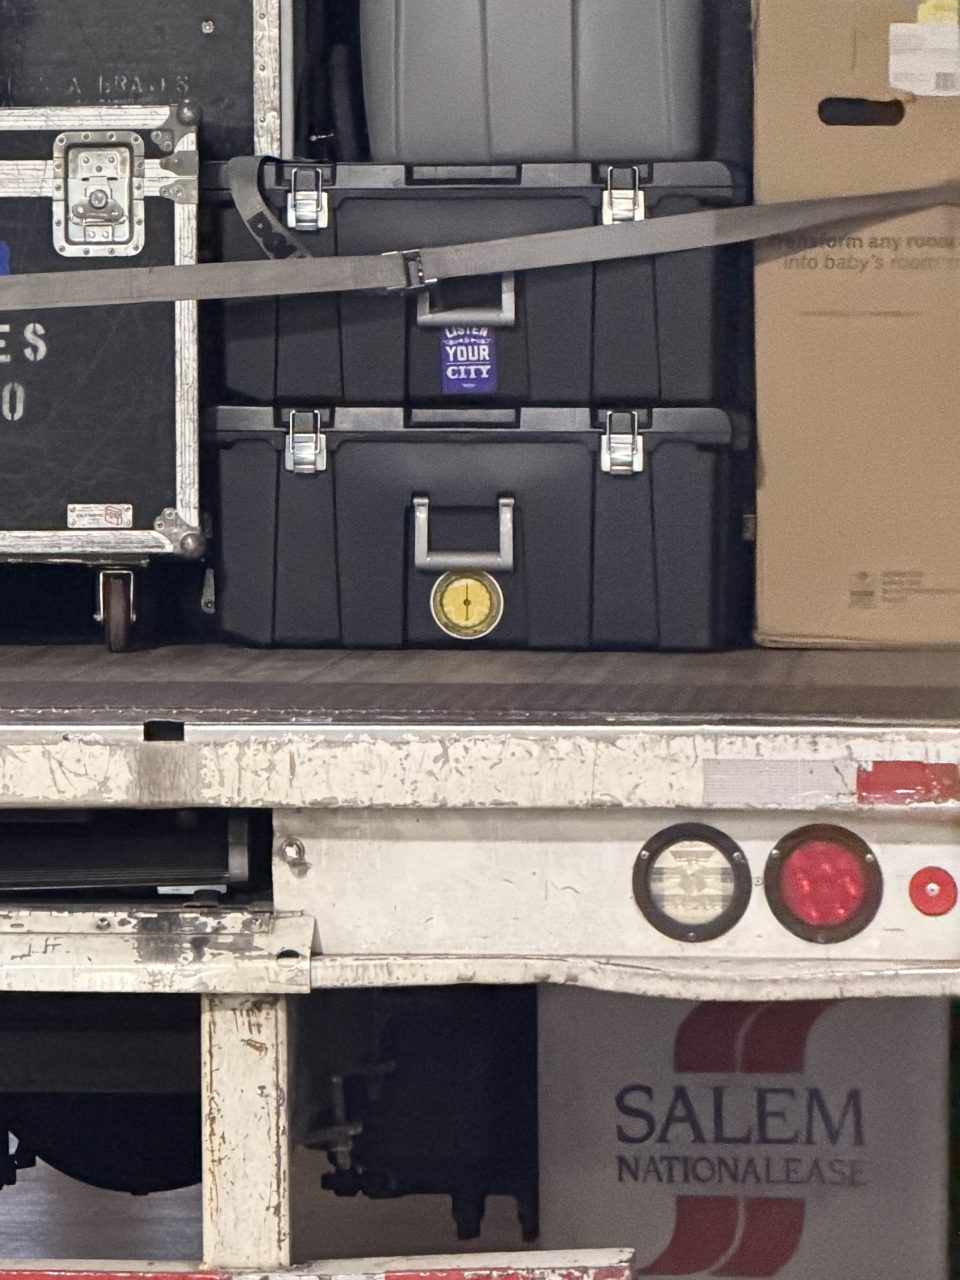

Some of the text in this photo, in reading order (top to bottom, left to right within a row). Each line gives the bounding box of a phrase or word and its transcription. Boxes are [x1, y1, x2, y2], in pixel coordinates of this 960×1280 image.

[868, 236, 898, 251] any
[784, 256, 818, 270] into
[824, 255, 883, 272] baby's
[445, 345, 490, 362] YOUR
[446, 365, 491, 379] CITY
[615, 1084, 865, 1145] SALEM
[616, 1153, 867, 1187] NATIONALEASE
